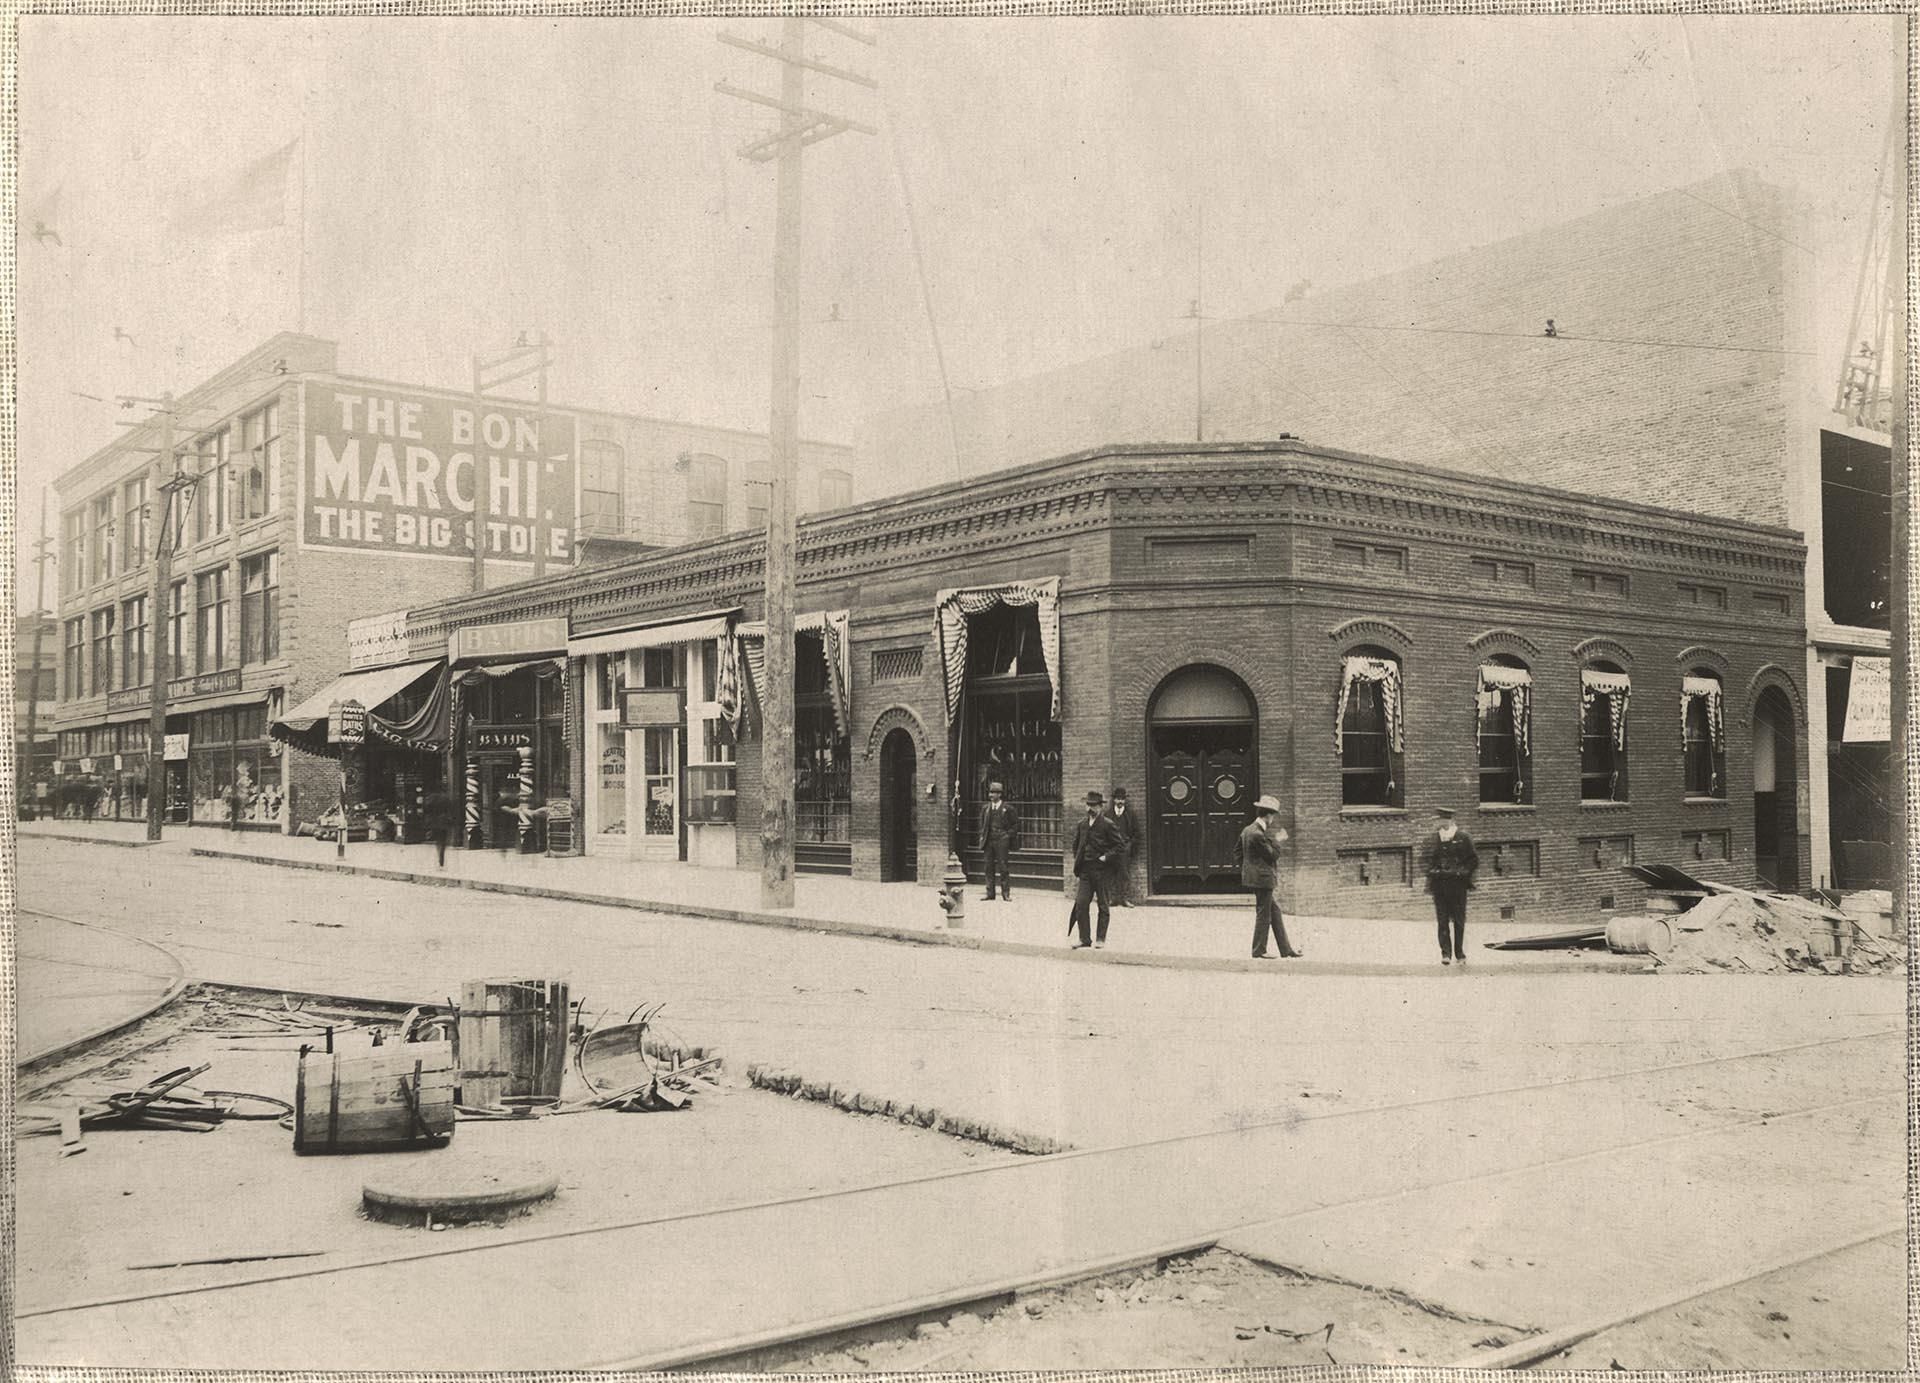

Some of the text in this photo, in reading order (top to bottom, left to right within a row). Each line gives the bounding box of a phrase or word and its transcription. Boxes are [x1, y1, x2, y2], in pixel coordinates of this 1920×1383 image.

[334, 392, 540, 453] THE BON
[313, 506, 383, 543] THE
[395, 514, 451, 549] BIG
[467, 624, 558, 650] BATHS
